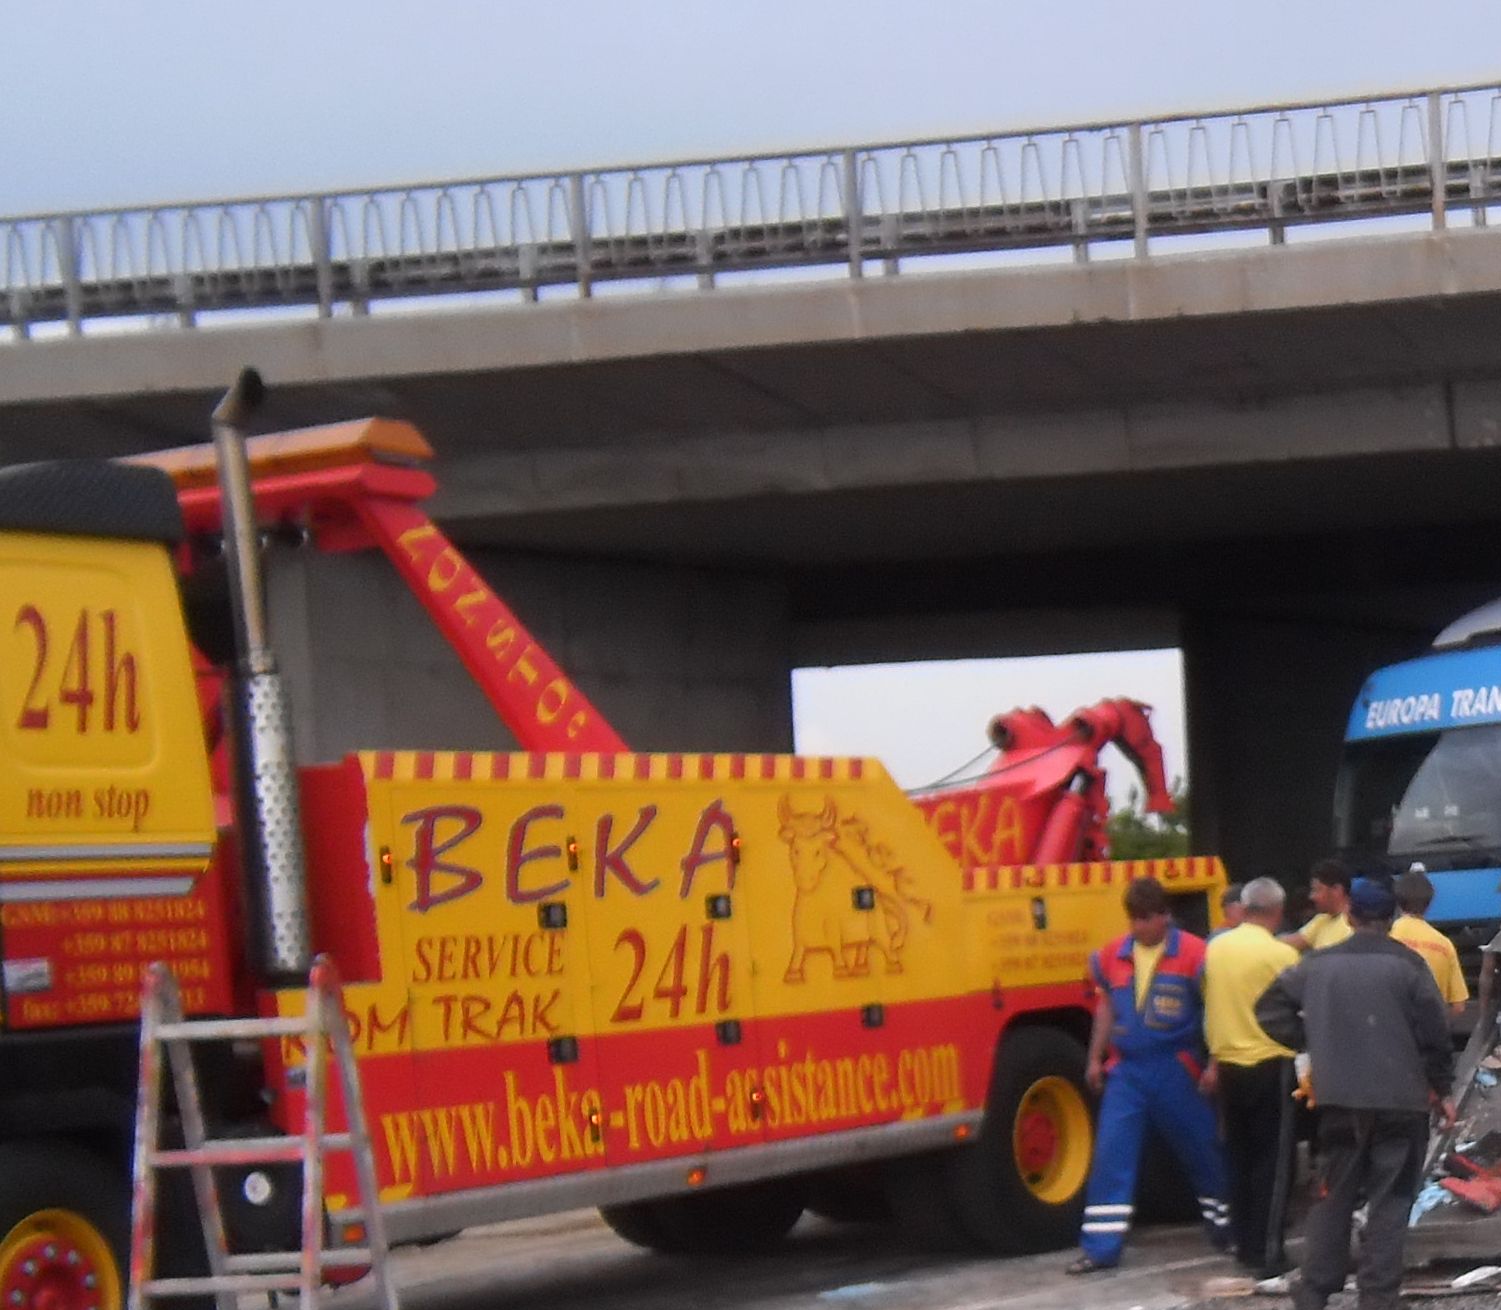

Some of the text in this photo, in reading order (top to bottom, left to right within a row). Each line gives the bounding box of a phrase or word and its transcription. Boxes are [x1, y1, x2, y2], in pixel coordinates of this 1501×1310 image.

[13, 603, 142, 735] 24h
[1364, 692, 1442, 730] EUROPA
[26, 784, 150, 833] non stop
[400, 797, 740, 915] BEKA
[411, 932, 566, 984] SERVICE
[608, 920, 733, 1025] 24h
[431, 988, 562, 1042] TRAK
[381, 1038, 962, 1187] www.beka-road-assistance.com
